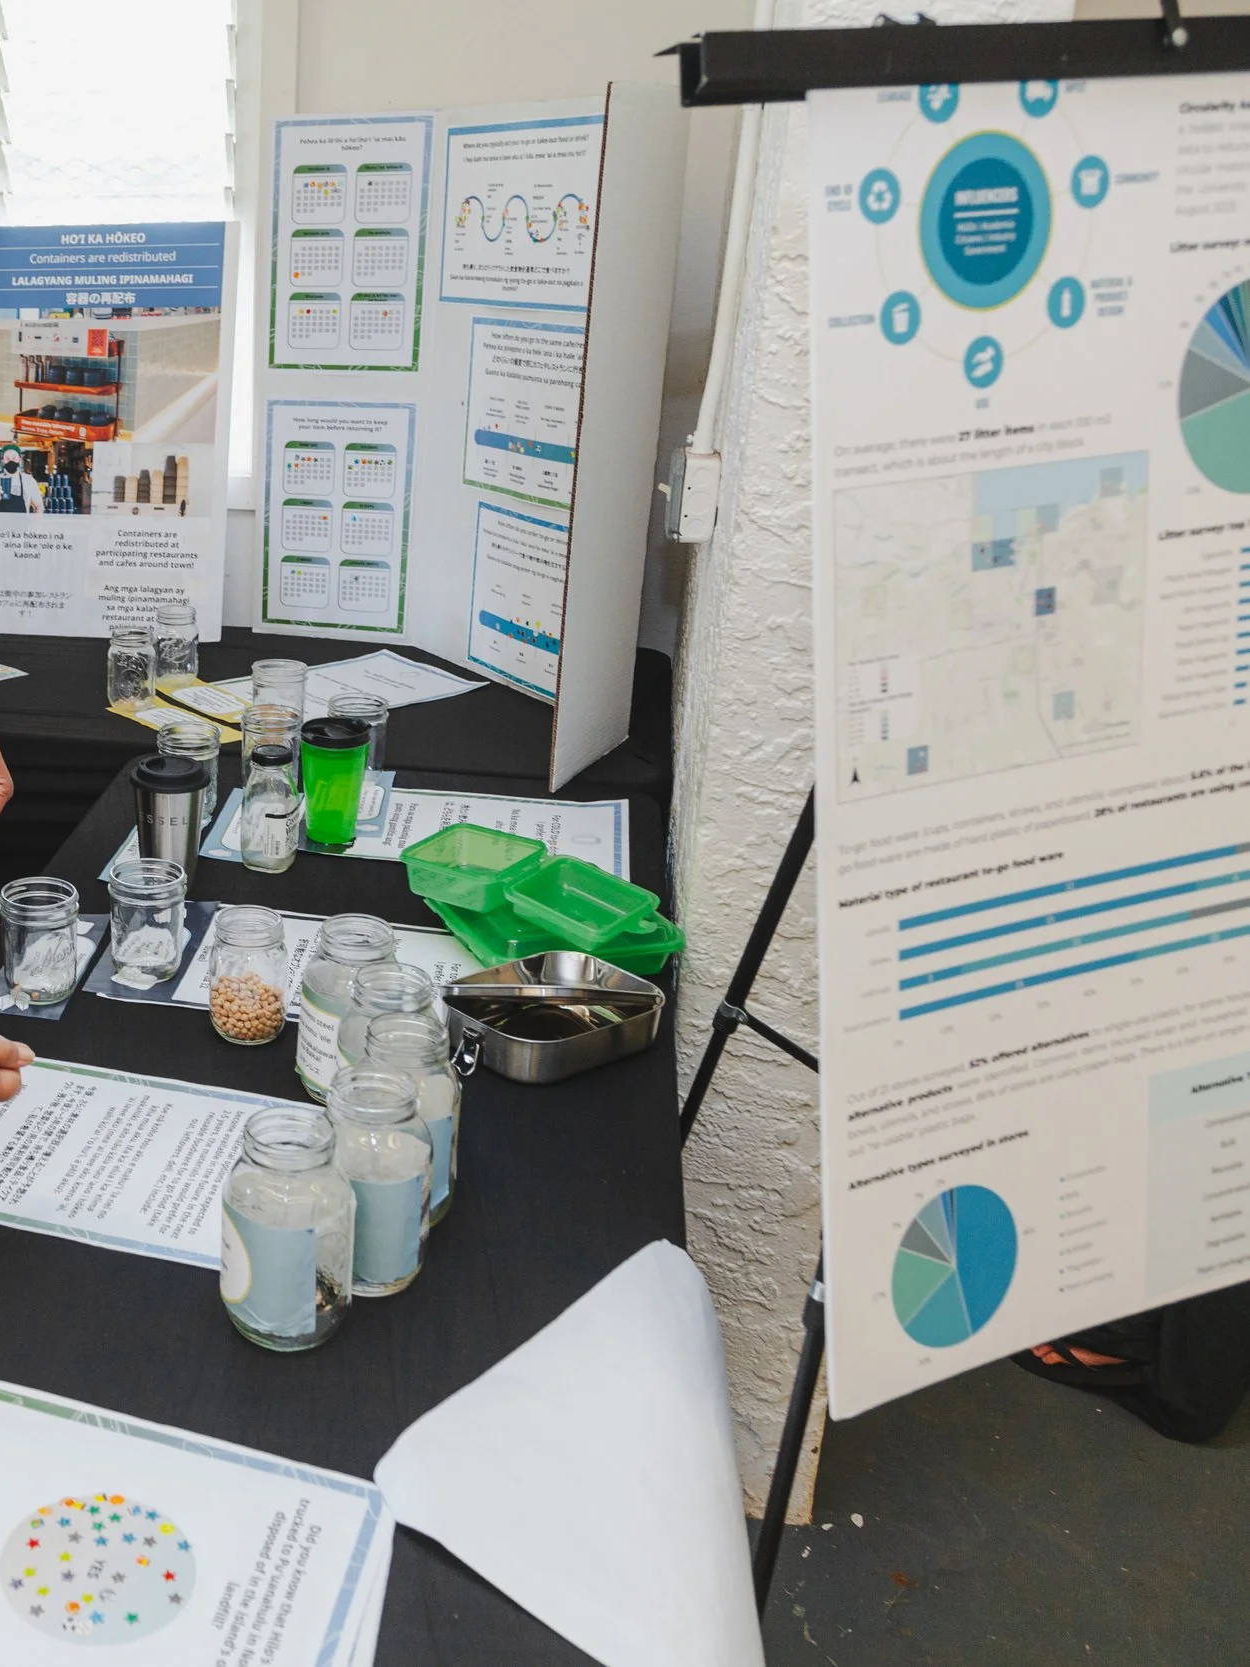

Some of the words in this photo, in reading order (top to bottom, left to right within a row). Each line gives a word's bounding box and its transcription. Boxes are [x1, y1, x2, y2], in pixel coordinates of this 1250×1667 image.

[88, 233, 103, 244] KA
[106, 231, 145, 244] HŌKEO
[30, 252, 86, 265] Containers
[88, 253, 104, 263] are
[107, 251, 176, 263] redistributed
[12, 274, 72, 286] LALAGYANG
[75, 274, 117, 285] MULING
[120, 274, 194, 284] IPINAMAHAGI
[66, 292, 136, 305] 容器の再配布
[958, 431, 972, 442] 27
[974, 429, 1001, 440] litter
[1004, 424, 1035, 436] items
[12, 531, 21, 539] ka
[118, 530, 161, 538] Containers
[23, 541, 37, 549] like
[115, 539, 168, 548] redistributed
[14, 551, 41, 559] kaona!
[96, 550, 148, 560] participating
[150, 551, 198, 559] restaurants
[99, 559, 114, 567] and
[116, 559, 136, 567] cafes
[139, 559, 169, 568] around
[171, 561, 194, 569] town!
[104, 584, 119, 594] Ang
[122, 586, 138, 594] mga
[140, 585, 173, 595] lalagyan
[175, 587, 185, 595] ay
[98, 594, 125, 604] muling
[117, 605, 134, 613] mga
[102, 613, 145, 621] restaurant
[139, 811, 188, 826] ESSEL
[839, 892, 881, 908] Material
[886, 888, 908, 899] type
[912, 882, 922, 892] of
[925, 869, 980, 888] restaurant
[982, 863, 1008, 875] to-go
[1013, 857, 1035, 868] food
[220, 1110, 231, 1118] 2-5
[226, 1110, 245, 1132] become
[186, 1118, 198, 1129] out,
[197, 1112, 215, 1136] reusable
[209, 1118, 224, 1136] years,
[171, 1130, 193, 1157] leftovers,
[204, 1137, 216, 1147] the
[212, 1133, 231, 1160] available
[181, 1137, 204, 1166] foodware
[162, 1160, 175, 1172] deli,
[188, 1148, 209, 1177] materials
[176, 1167, 187, 1176] for
[202, 1168, 214, 1178] the
[214, 1160, 233, 1184] options
[165, 1184, 175, 1192] go
[176, 1182, 191, 1202] would
[190, 1179, 208, 1202] future.
[208, 1184, 219, 1195] are
[157, 1194, 172, 1209] food
[146, 1209, 163, 1226] (take
[164, 1202, 180, 1223] prefer
[179, 1211, 191, 1222] the
[192, 1196, 213, 1227] expected
[158, 1224, 170, 1234] for
[170, 1223, 184, 1239] next
[285, 1498, 310, 1542] trucked
[258, 1510, 287, 1560] disposed
[305, 1524, 321, 1544] Did
[280, 1543, 293, 1555] to
[295, 1543, 311, 1567] you
[87, 1559, 106, 1580] YES
[253, 1560, 266, 1575] of
[248, 1575, 262, 1588] in
[284, 1568, 305, 1601] know
[211, 1581, 240, 1629] landfill?
[239, 1589, 255, 1609] the
[274, 1603, 292, 1628] that
[219, 1610, 248, 1656] island's
[246, 1632, 257, 1646] in
[260, 1631, 282, 1667] Hilo's
